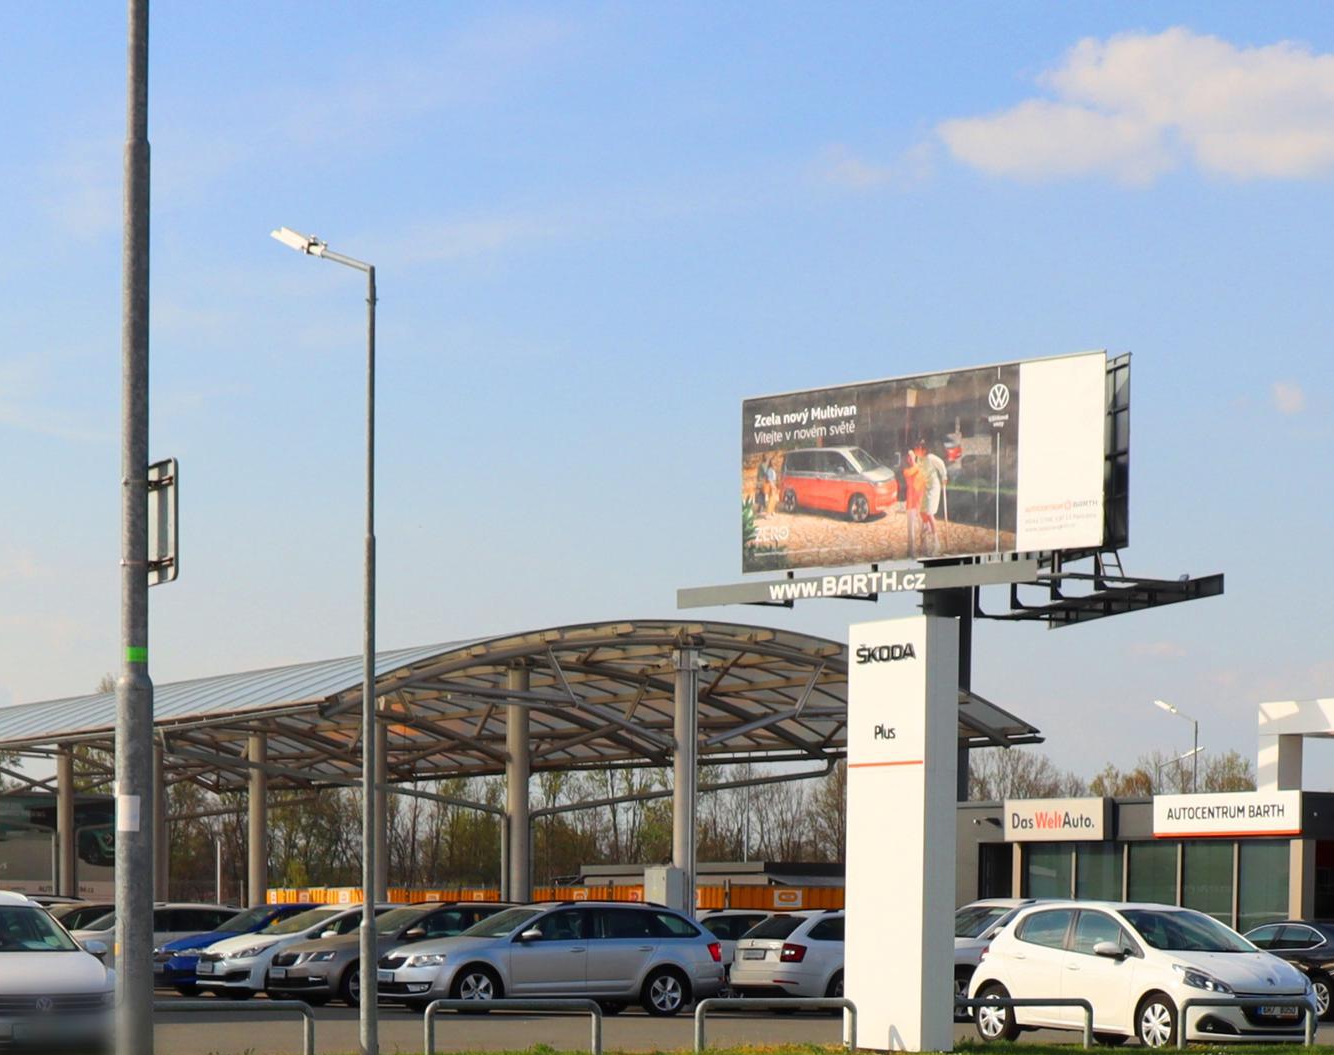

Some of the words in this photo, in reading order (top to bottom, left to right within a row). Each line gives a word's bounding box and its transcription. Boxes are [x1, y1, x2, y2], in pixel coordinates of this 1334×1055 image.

[754, 412, 781, 427] Zcela
[783, 407, 809, 425] nový
[811, 404, 857, 420] Multivan
[785, 431, 791, 441] v
[793, 424, 827, 440] novém
[829, 419, 856, 436] světě
[769, 572, 926, 600] www.BARTH.cz
[856, 643, 916, 664] ŠKODA
[874, 724, 896, 740] Plus
[1012, 812, 1034, 829] Das
[1167, 805, 1245, 820] AUTOCENTRUM
[1248, 804, 1285, 818] BARTH
